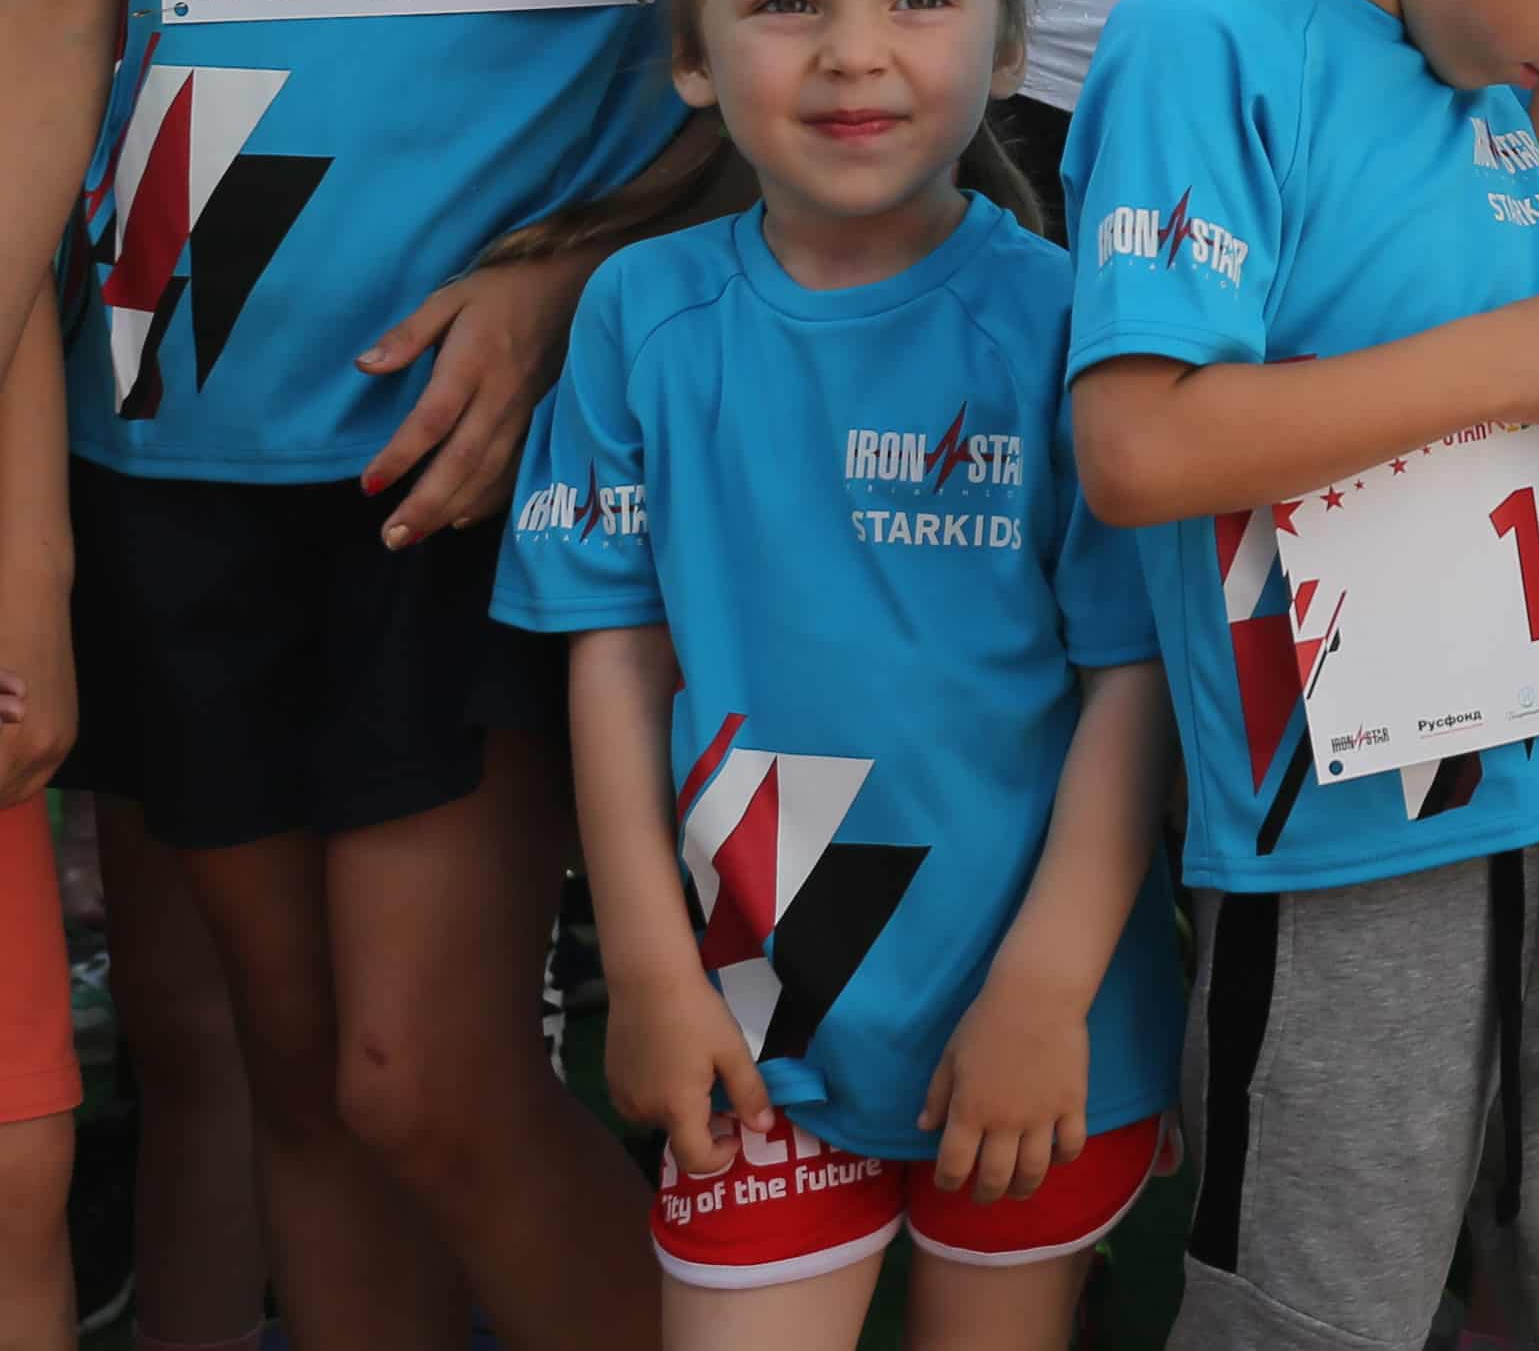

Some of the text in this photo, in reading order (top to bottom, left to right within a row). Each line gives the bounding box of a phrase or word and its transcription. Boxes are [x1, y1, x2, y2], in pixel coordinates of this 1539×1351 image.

[967, 434, 1023, 486] STA
[600, 484, 648, 537] STA
[852, 511, 1023, 550] STARKIDS
[1418, 710, 1482, 732] Русфонд
[661, 1157, 883, 1226] ity of the future
